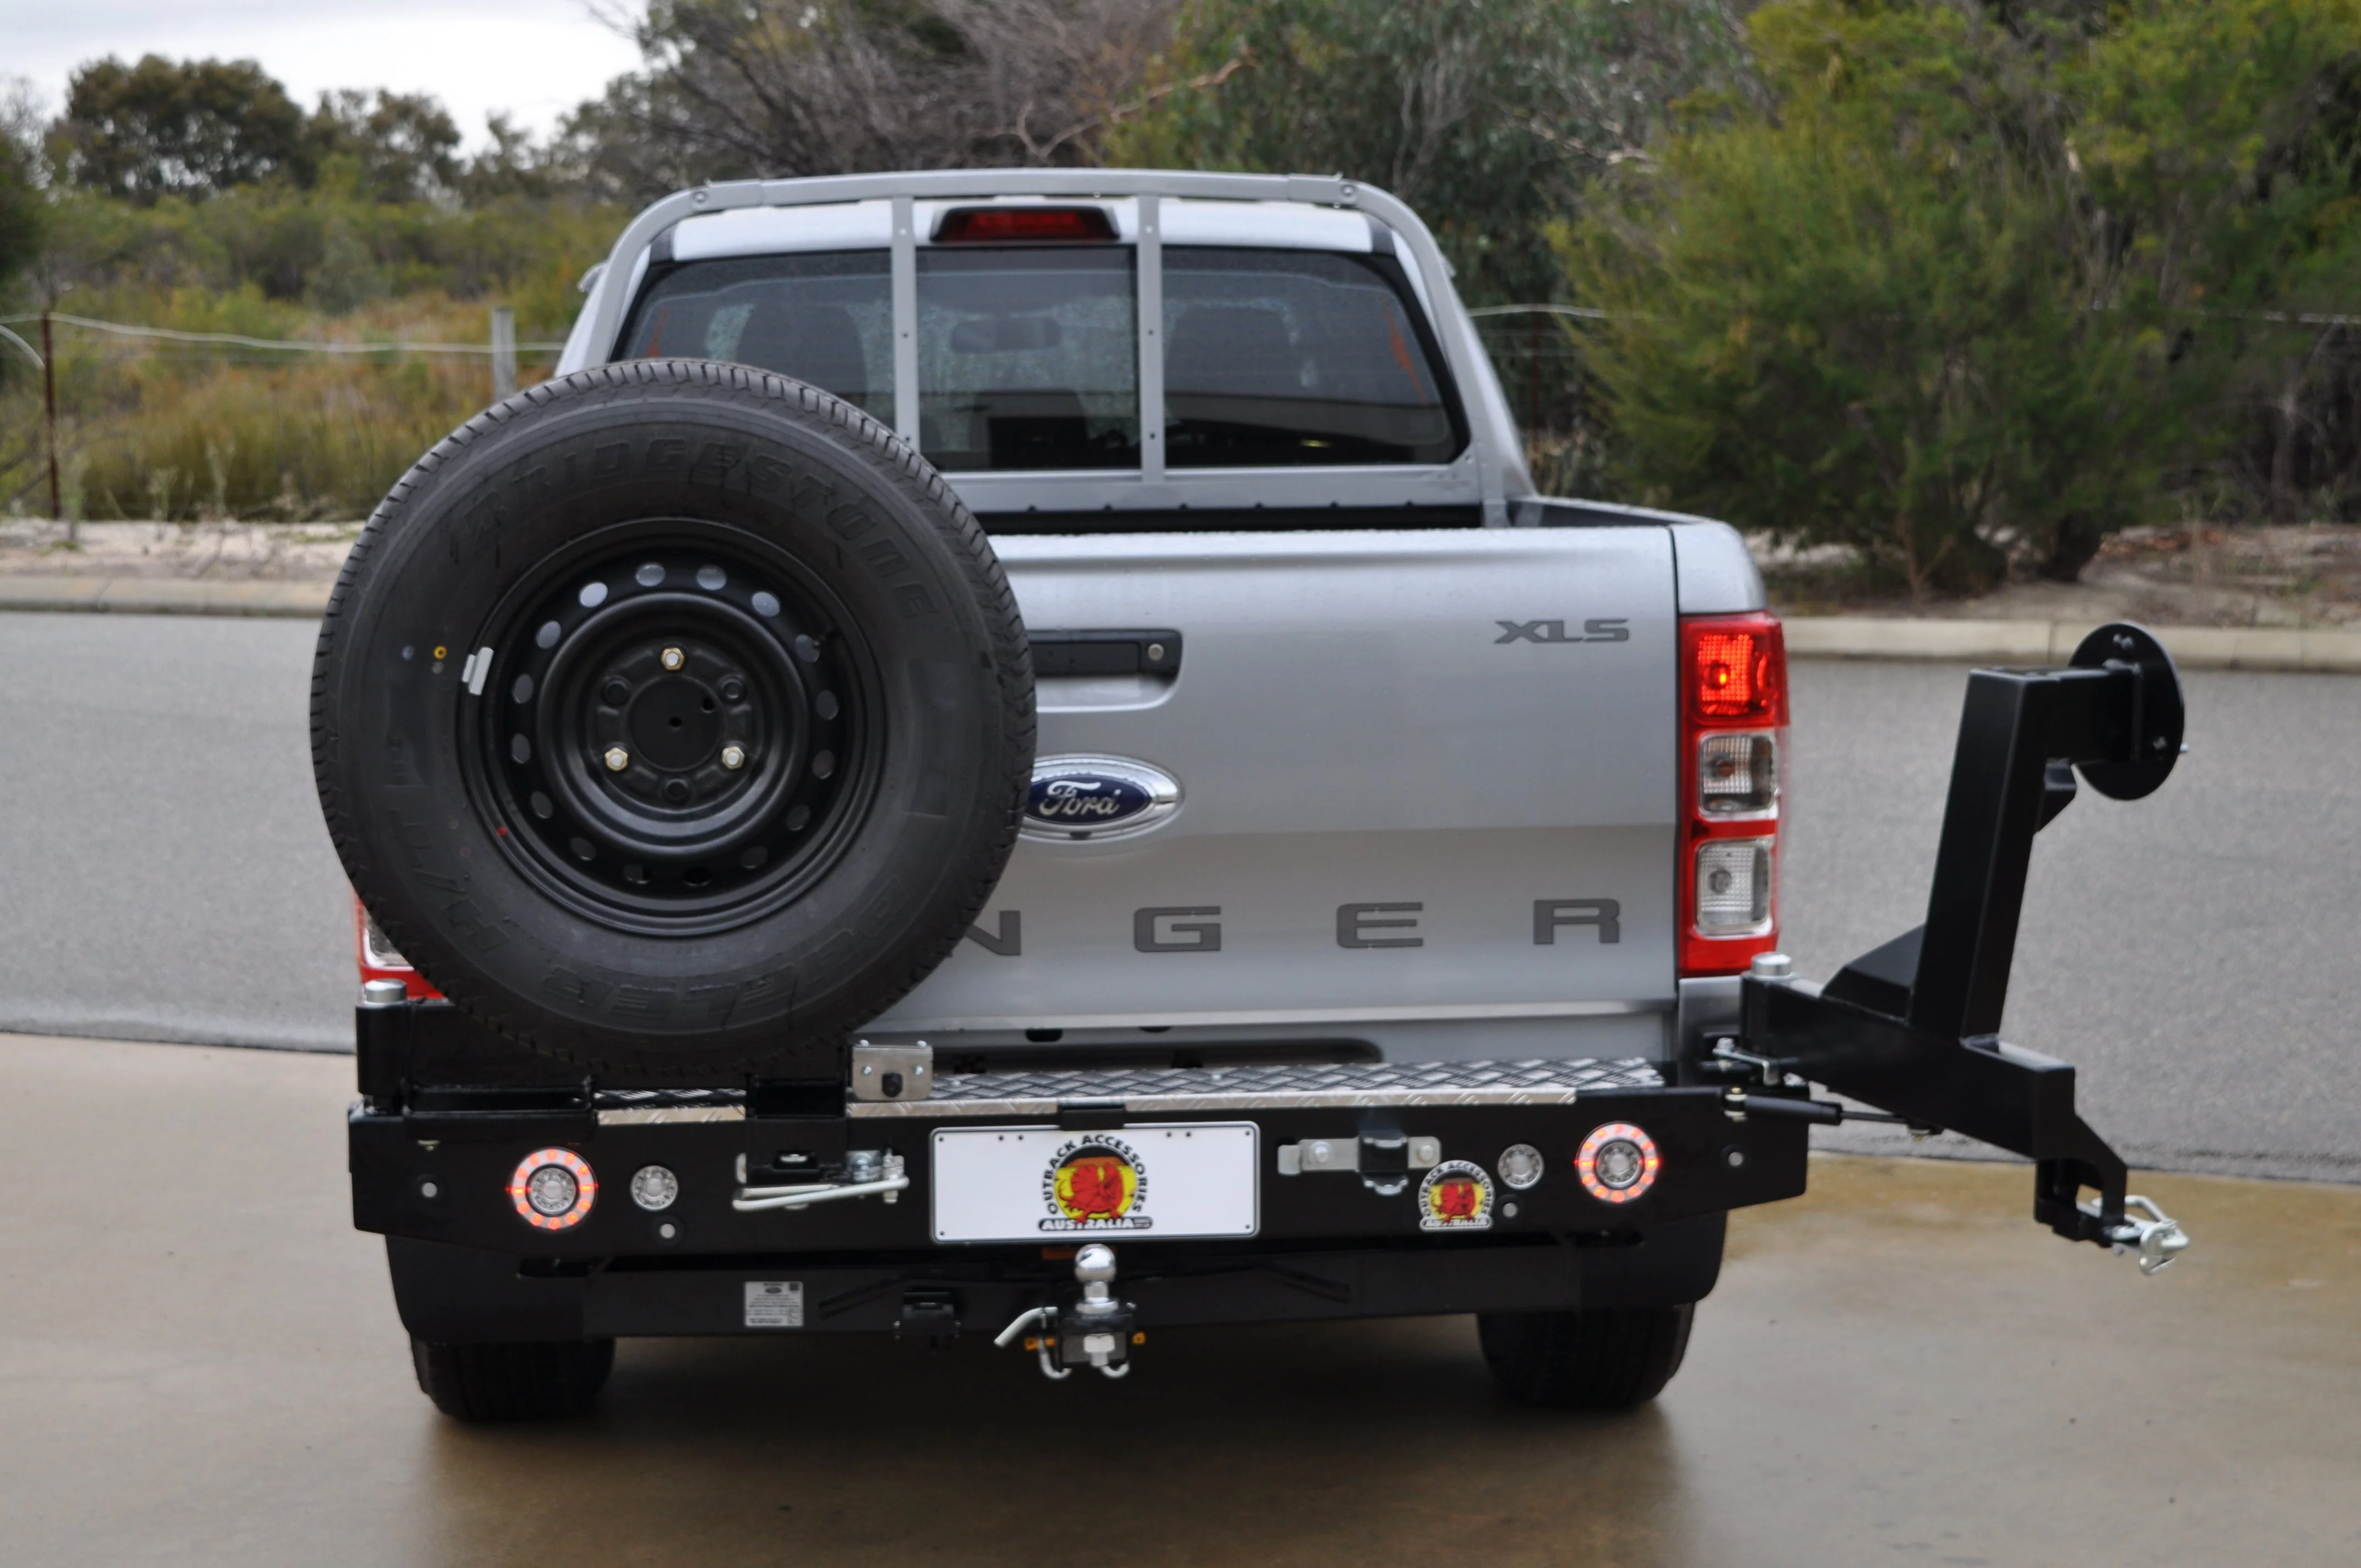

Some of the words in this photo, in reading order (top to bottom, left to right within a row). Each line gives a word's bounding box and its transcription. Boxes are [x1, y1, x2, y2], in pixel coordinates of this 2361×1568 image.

[460, 439, 937, 617] BRIDGESTONE
[1494, 618, 1630, 644] XLS
[1038, 780, 1122, 816] Ford
[965, 897, 1620, 956] NGER
[1043, 1140, 1076, 1215] OUTBACK
[1081, 1134, 1147, 1212] ACCESSORIES
[1041, 1218, 1135, 1229] AUSTRALIA
